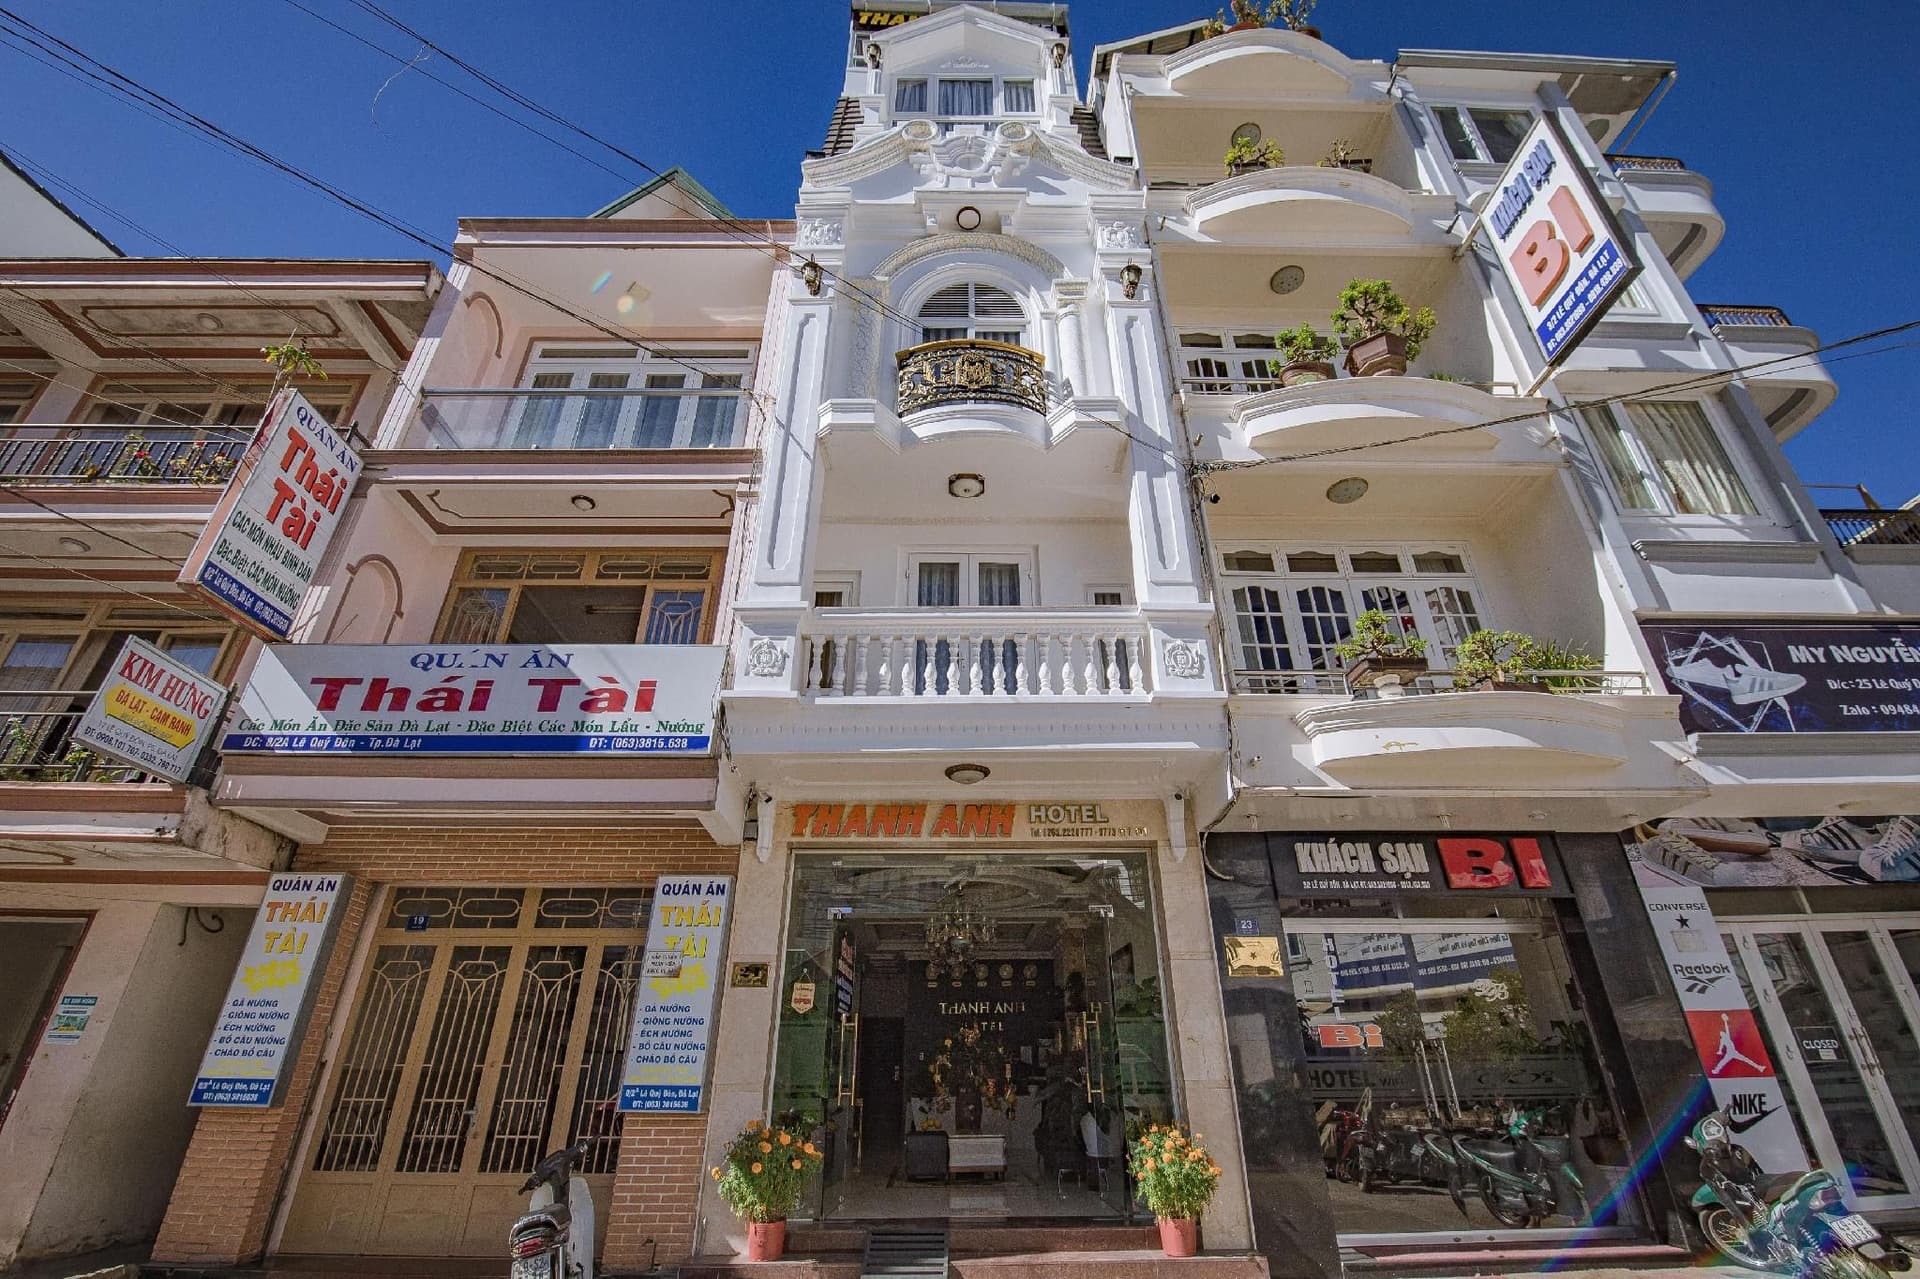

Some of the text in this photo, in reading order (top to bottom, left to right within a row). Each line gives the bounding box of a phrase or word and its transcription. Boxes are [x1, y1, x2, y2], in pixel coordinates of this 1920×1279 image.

[1490, 173, 1535, 242] KHÁCH
[1509, 185, 1594, 312] BI
[295, 406, 359, 474] QUÁN ĂN
[280, 426, 349, 516] Thái
[265, 477, 321, 551] Tài
[232, 510, 251, 534] CÁC
[247, 521, 267, 545] MÓN
[247, 560, 265, 583] CÁC
[261, 571, 280, 595] MÓN
[520, 650, 574, 669] ĂN
[1788, 645, 1827, 664] MY
[118, 650, 167, 695] KIM
[310, 675, 657, 713] Thái Tài
[1856, 679, 1872, 689] 25
[1872, 679, 1889, 689] Lê
[1889, 678, 1912, 691] Quý
[1839, 704, 1870, 715] Zalo
[150, 707, 170, 727] CAM
[168, 715, 193, 737] RANH
[238, 718, 265, 732] Các
[269, 718, 301, 732] Món
[305, 716, 328, 732] Ăn
[333, 719, 361, 735] Đặc
[399, 719, 419, 732] Đà
[425, 720, 450, 735] Lạt
[467, 719, 495, 735] Đặc
[501, 719, 532, 735] Biệt
[538, 719, 566, 732] Các
[571, 719, 604, 732] Món
[656, 718, 705, 735] Nướng
[243, 737, 262, 748] ĐC:
[292, 737, 304, 748] Lê
[310, 737, 331, 749] Quý
[334, 737, 355, 748] Đôn
[403, 737, 422, 750] Lạt
[589, 738, 688, 749] ĐT: (063)3815.638
[791, 804, 1017, 838] THANH ANH
[1029, 804, 1109, 823] HOTEL
[1294, 837, 1430, 880] KHÁCH SẠN
[1437, 838, 1552, 889] BI
[272, 876, 337, 892] QUÁN ĂN
[661, 881, 726, 896] QUÁN ĂN
[265, 896, 328, 923] THÁI
[660, 899, 721, 927] THÁI
[1648, 902, 1708, 912] CONVERSE
[413, 916, 425, 925] 19
[1240, 920, 1253, 929] 23
[264, 928, 308, 954] TÀI
[1673, 963, 1731, 975] Reebok
[939, 1001, 1025, 1015] THANH ANH
[1318, 1024, 1385, 1049] Bi
[1802, 1039, 1839, 1049] CLOSED
[1308, 1069, 1376, 1088] HOTEL
[1731, 1093, 1767, 1115] NIKE
